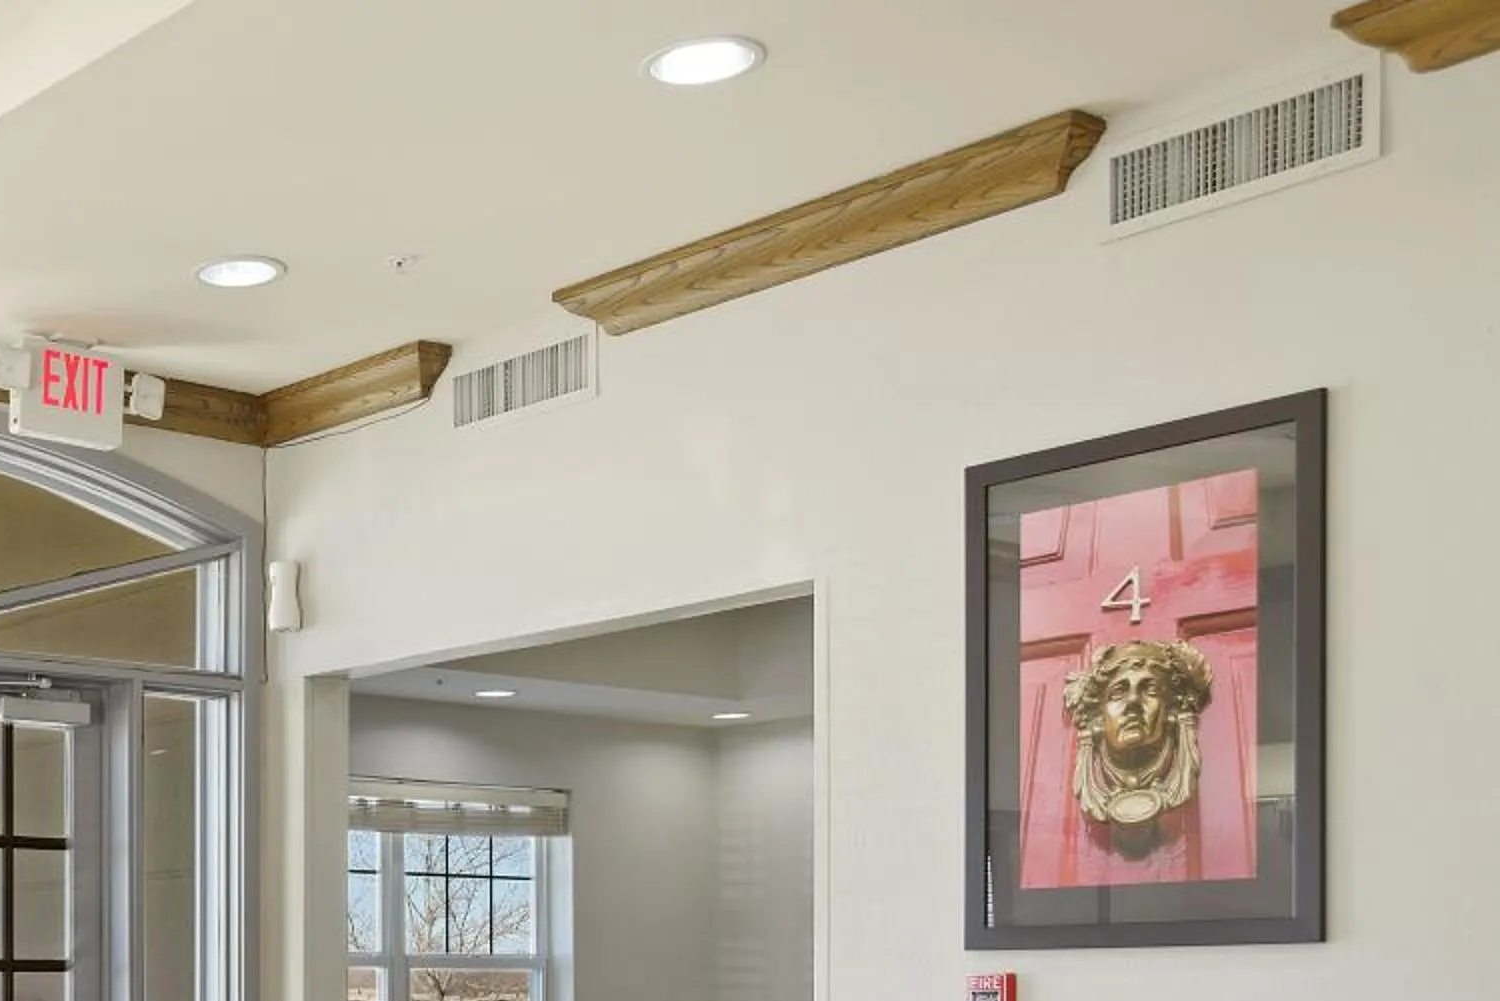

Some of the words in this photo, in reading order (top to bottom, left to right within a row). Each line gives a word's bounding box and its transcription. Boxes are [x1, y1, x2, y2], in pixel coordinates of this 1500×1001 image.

[42, 349, 111, 416] EXIT
[1100, 565, 1152, 622] 4
[971, 977, 1002, 989] FIRE
